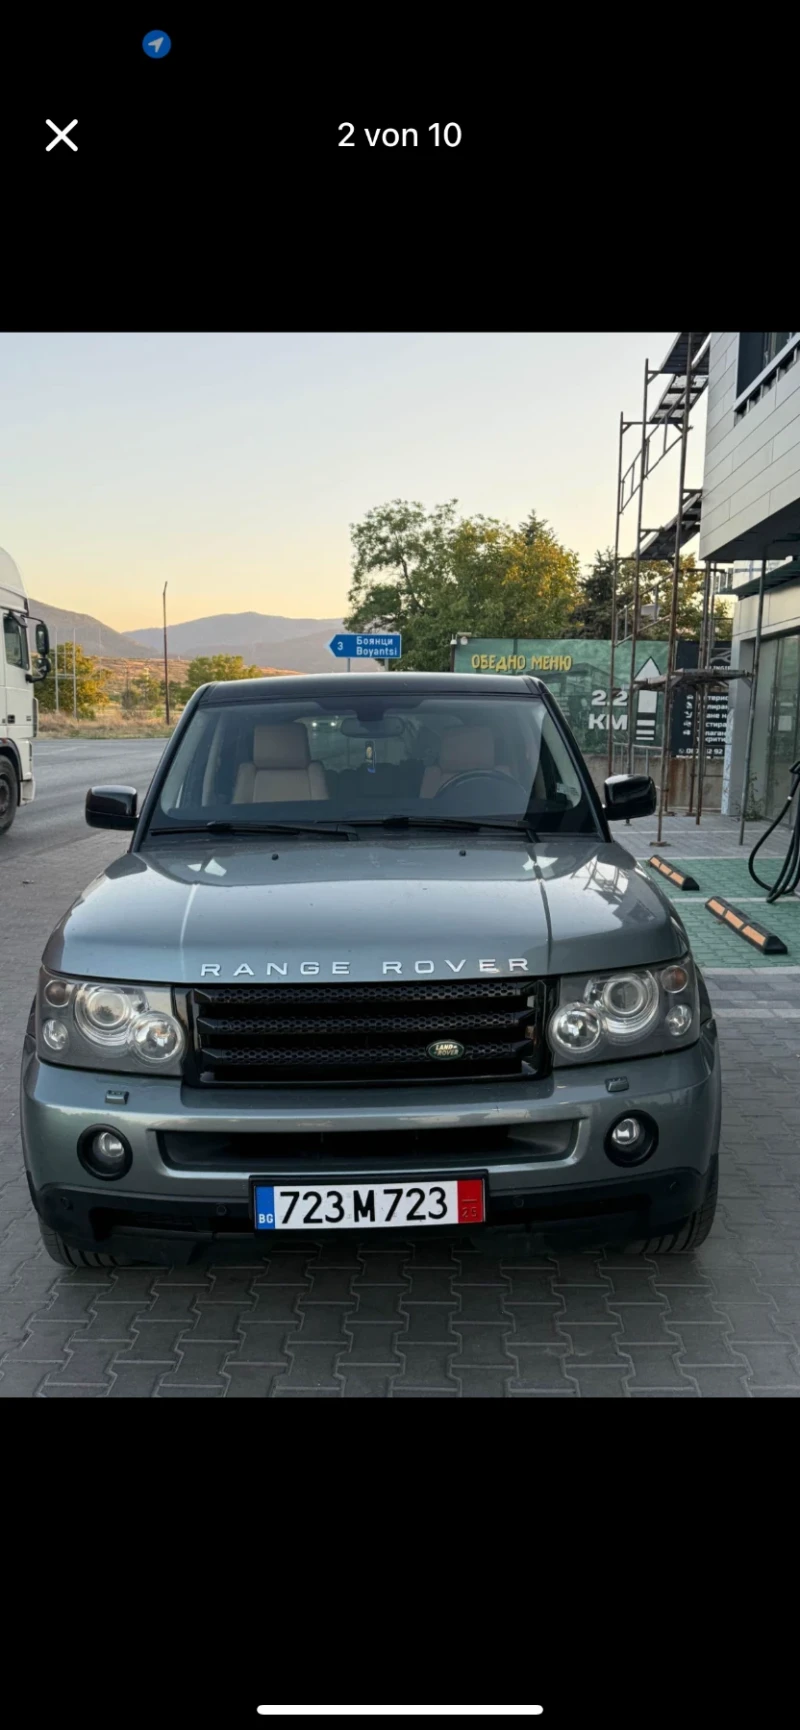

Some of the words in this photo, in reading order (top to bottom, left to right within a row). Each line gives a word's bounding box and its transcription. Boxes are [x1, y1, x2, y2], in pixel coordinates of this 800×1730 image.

[337, 641, 344, 651] 3
[356, 636, 393, 646] Боянци
[356, 646, 398, 657] Boyantsi
[471, 654, 526, 672] ОБЕДНО
[531, 655, 573, 671] МЕНЮ
[200, 961, 350, 977] RANGE
[382, 958, 529, 975] ROVER
[280, 1190, 345, 1224] 723
[353, 1190, 375, 1223] M
[383, 1186, 448, 1222] 723
[258, 1213, 273, 1224] BG
